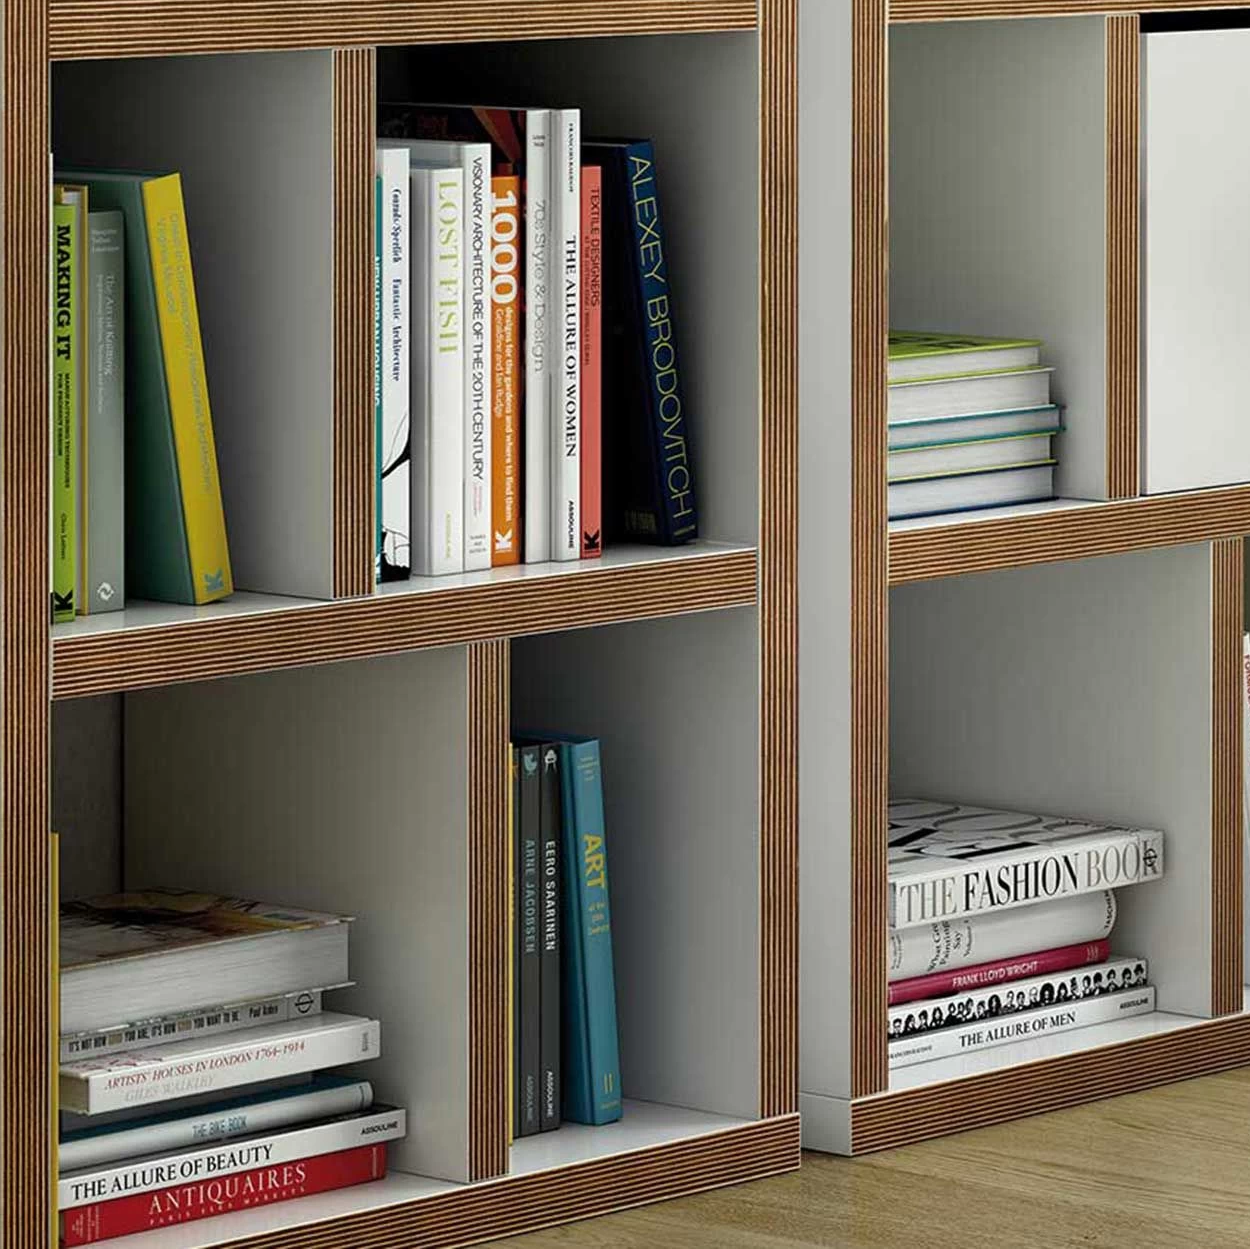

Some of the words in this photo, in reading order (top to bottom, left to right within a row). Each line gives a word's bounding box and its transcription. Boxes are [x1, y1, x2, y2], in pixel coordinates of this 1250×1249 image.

[472, 157, 484, 220] VISIONARY
[439, 181, 459, 269] LOST
[534, 200, 546, 230] 70s
[590, 187, 600, 234] TEXTILE
[490, 190, 518, 304] 1000
[532, 234, 546, 281] Style
[565, 236, 577, 259] THE
[57, 225, 71, 327] MAKING
[105, 274, 115, 295] The
[472, 222, 484, 319] ARCHITECTURE
[590, 239, 601, 307] DESIGNERS
[105, 296, 115, 313] Art
[392, 278, 402, 320] Fantastic
[535, 284, 545, 299] &
[439, 278, 459, 354] FISH
[472, 321, 484, 342] OF
[504, 306, 513, 342] designs
[565, 278, 577, 351] ALLURE
[57, 335, 71, 360] IT
[391, 325, 402, 382] Architecture
[504, 344, 513, 358] for
[532, 303, 546, 372] Design
[629, 156, 665, 283] ALEXEY
[647, 294, 692, 518] BRODOVITCH
[472, 344, 484, 371] THE
[494, 357, 504, 371] and
[504, 360, 513, 375] the
[565, 356, 577, 380] OF
[472, 373, 484, 410] 20TH
[504, 415, 513, 433] and
[565, 385, 577, 457] WOMEN
[472, 412, 484, 480] CENTURY
[504, 435, 513, 461] where
[504, 462, 513, 475] to
[504, 476, 513, 497] find
[504, 499, 513, 521] them
[525, 839, 536, 875] ARNE
[545, 841, 556, 875] EERO
[583, 833, 607, 890] ART
[900, 876, 957, 923] THE
[963, 852, 1080, 911] FASHION
[1086, 839, 1158, 888] BOOK
[525, 881, 536, 953] JACOBSEN
[545, 881, 556, 950] SAARINEN
[952, 975, 979, 988] FRANK
[979, 968, 1006, 982] LLOYD
[1005, 961, 1039, 976] WRIGHT
[81, 1037, 93, 1050] NOT
[93, 1035, 107, 1049] HOW
[124, 1030, 136, 1043] YOU
[163, 1022, 176, 1035] HOW
[194, 1016, 205, 1029] YOU
[206, 1013, 222, 1026] WANT
[223, 1012, 231, 1023] TO
[249, 1006, 261, 1019] Paul
[959, 1031, 985, 1047] THE
[986, 1024, 1031, 1043] ALLURE
[1031, 1017, 1048, 1030] OF
[1049, 1010, 1076, 1027] MEN
[152, 1062, 194, 1082] HOUSES
[195, 1060, 210, 1074] IN
[211, 1052, 252, 1070] LONDON
[546, 1071, 554, 1117] ASSOULINE
[192, 1124, 207, 1138] THE
[209, 1120, 227, 1136] BIKE
[228, 1116, 248, 1132] BOOK
[361, 1121, 399, 1135] ASSOULINE
[72, 1179, 107, 1200] THE
[111, 1164, 177, 1193] ALLURE
[180, 1158, 203, 1178] OF
[207, 1143, 273, 1171] BEAUTY
[149, 1163, 306, 1215] ANTIQUAIRES
